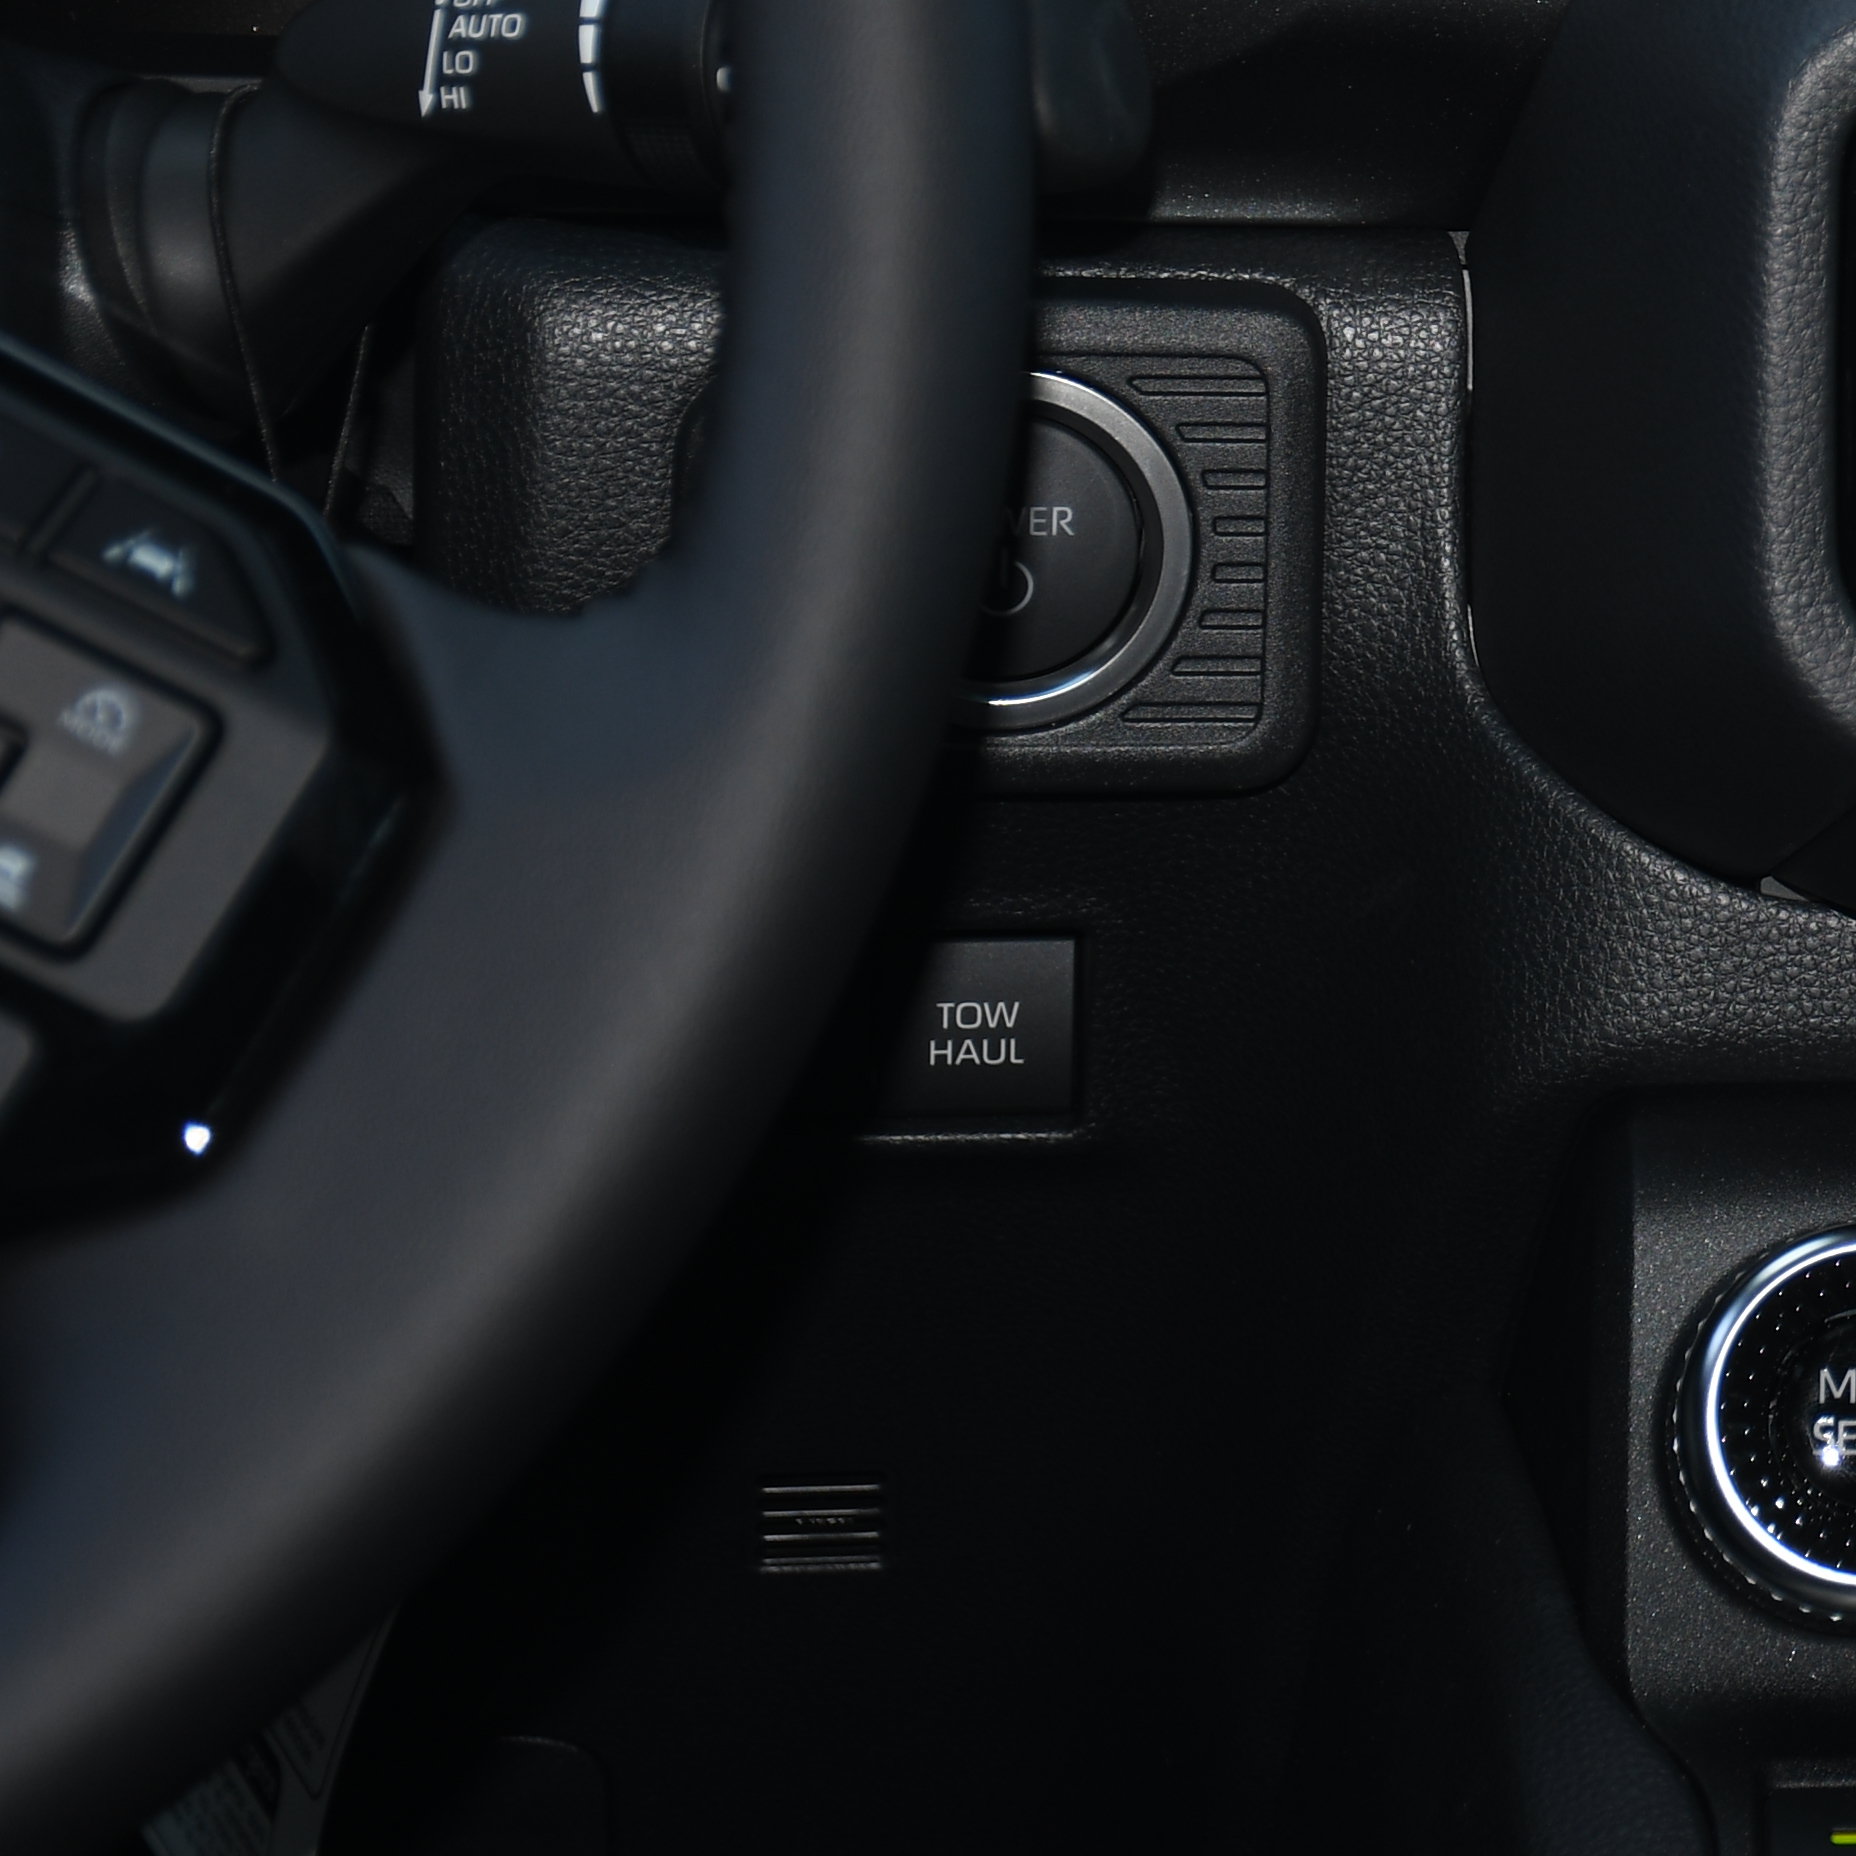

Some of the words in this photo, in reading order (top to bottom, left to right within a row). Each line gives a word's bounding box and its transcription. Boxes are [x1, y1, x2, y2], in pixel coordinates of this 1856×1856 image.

[448, 13, 524, 39] AUTO
[442, 50, 476, 74] LO
[440, 86, 468, 109] HI
[936, 1001, 1019, 1029] TOW
[929, 1038, 1024, 1066] HAUL
